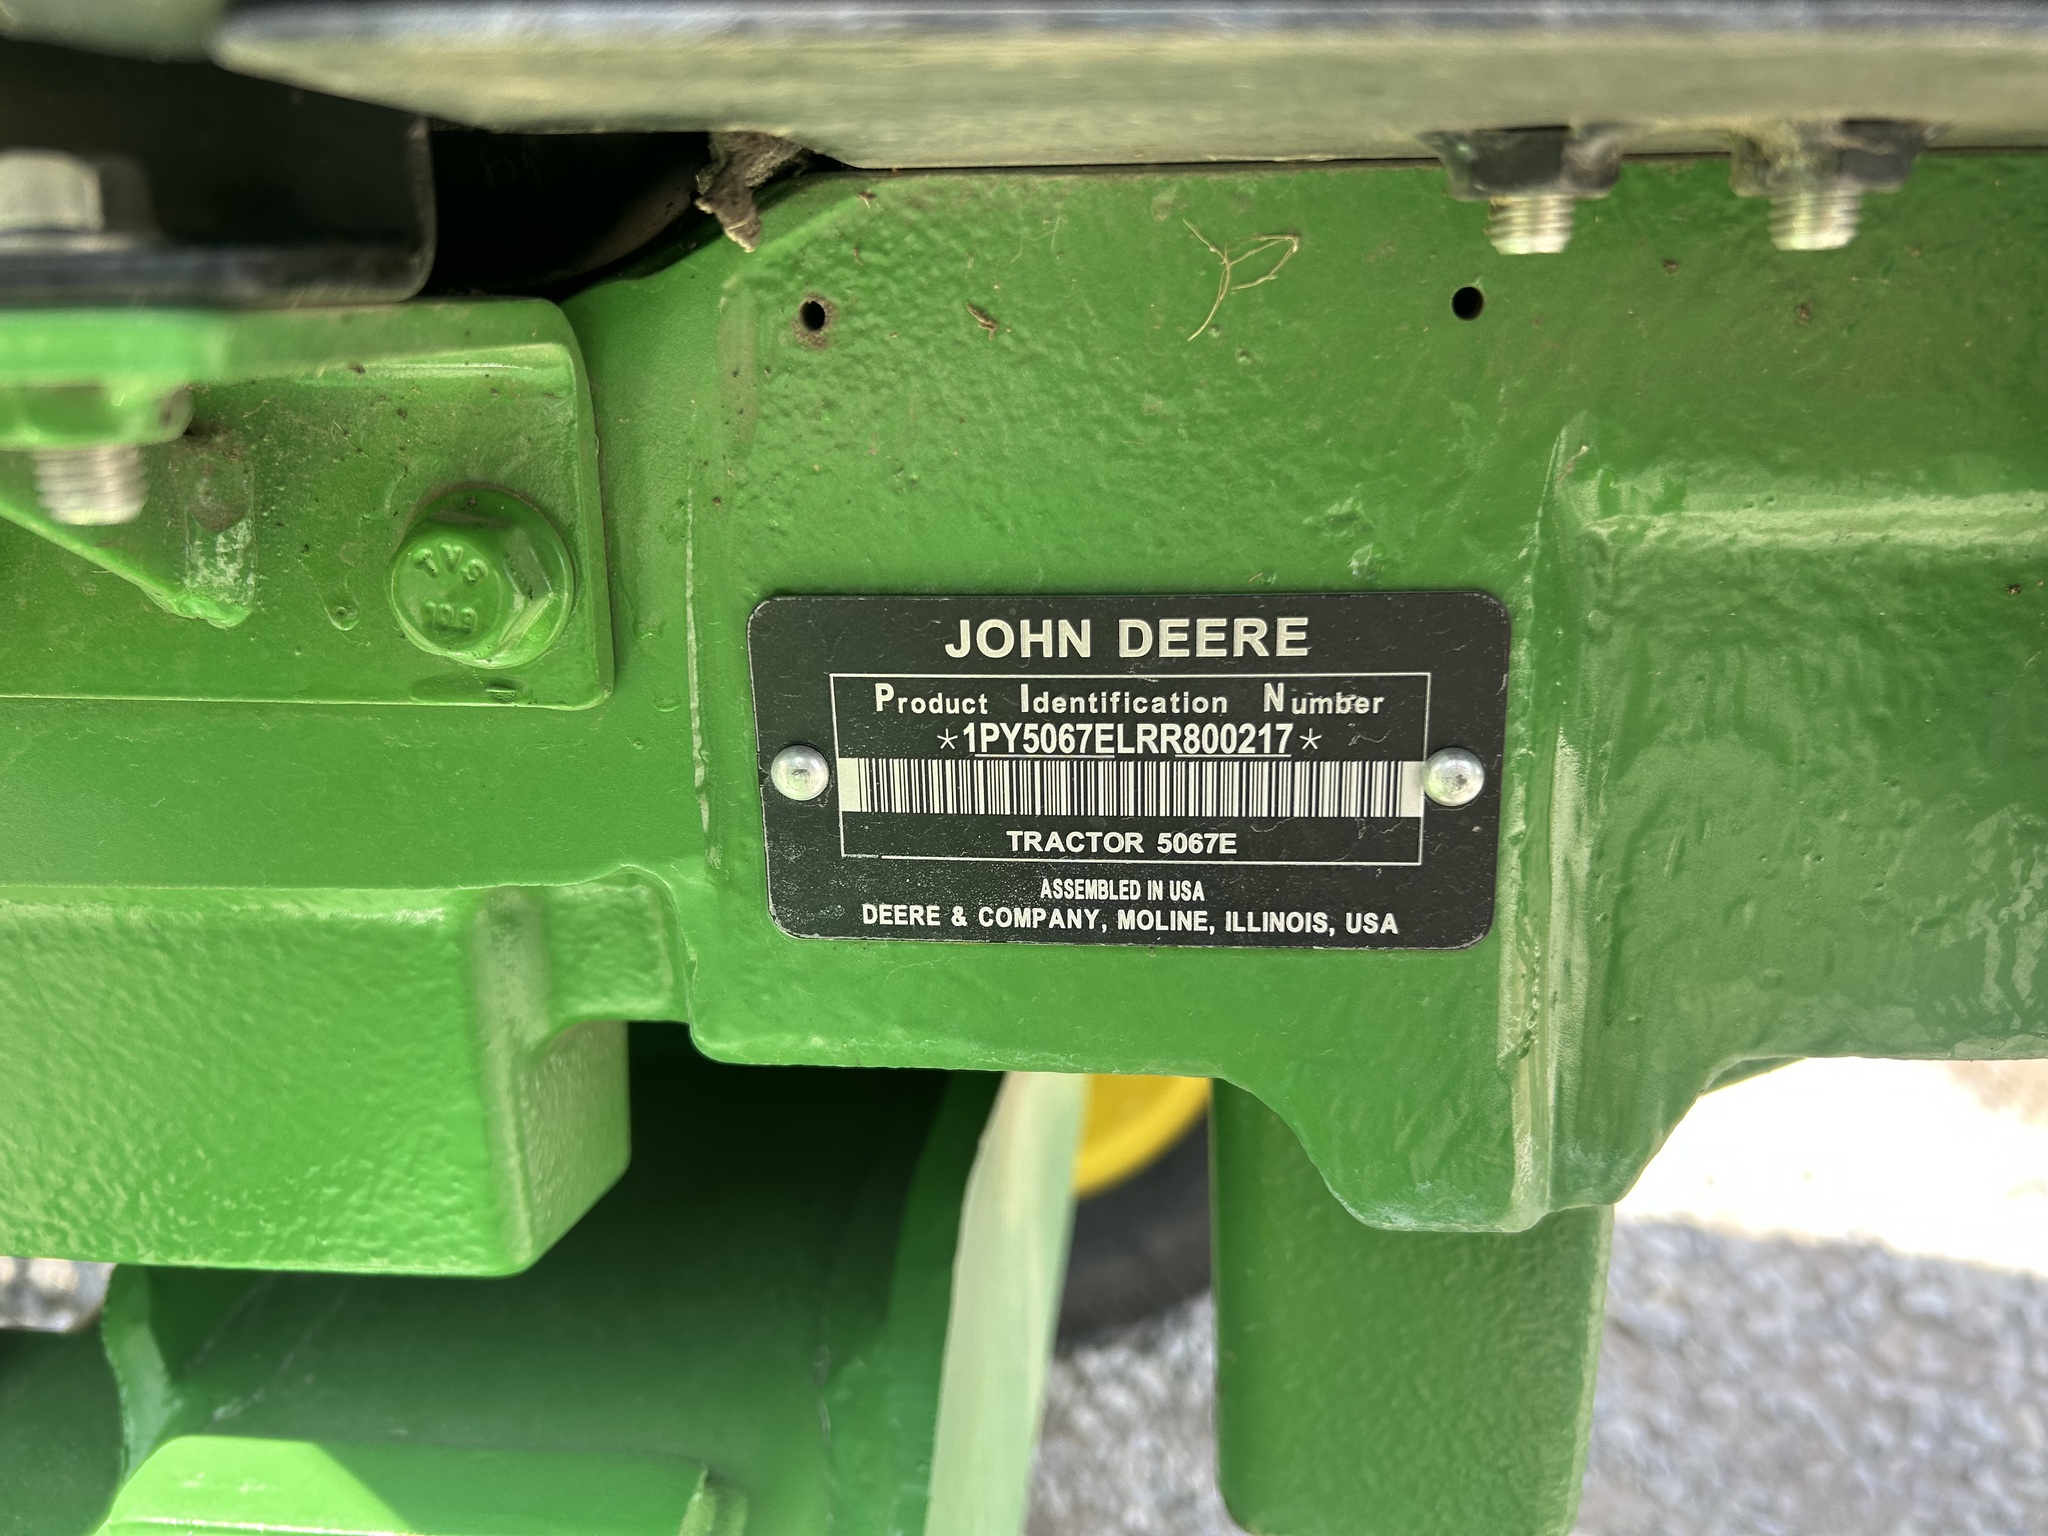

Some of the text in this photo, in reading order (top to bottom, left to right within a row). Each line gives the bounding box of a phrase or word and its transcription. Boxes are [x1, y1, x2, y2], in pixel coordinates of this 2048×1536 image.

[944, 617, 1309, 658] JOHN DEERE
[874, 682, 1385, 715] Product Identification Number
[1005, 830, 1238, 854] TRACTOR 5067E
[1039, 878, 1206, 902] ASSEMBLED IN USA
[861, 903, 1399, 937] DEERE & COMPANY, MOLINE, ILLINOIS, USA
